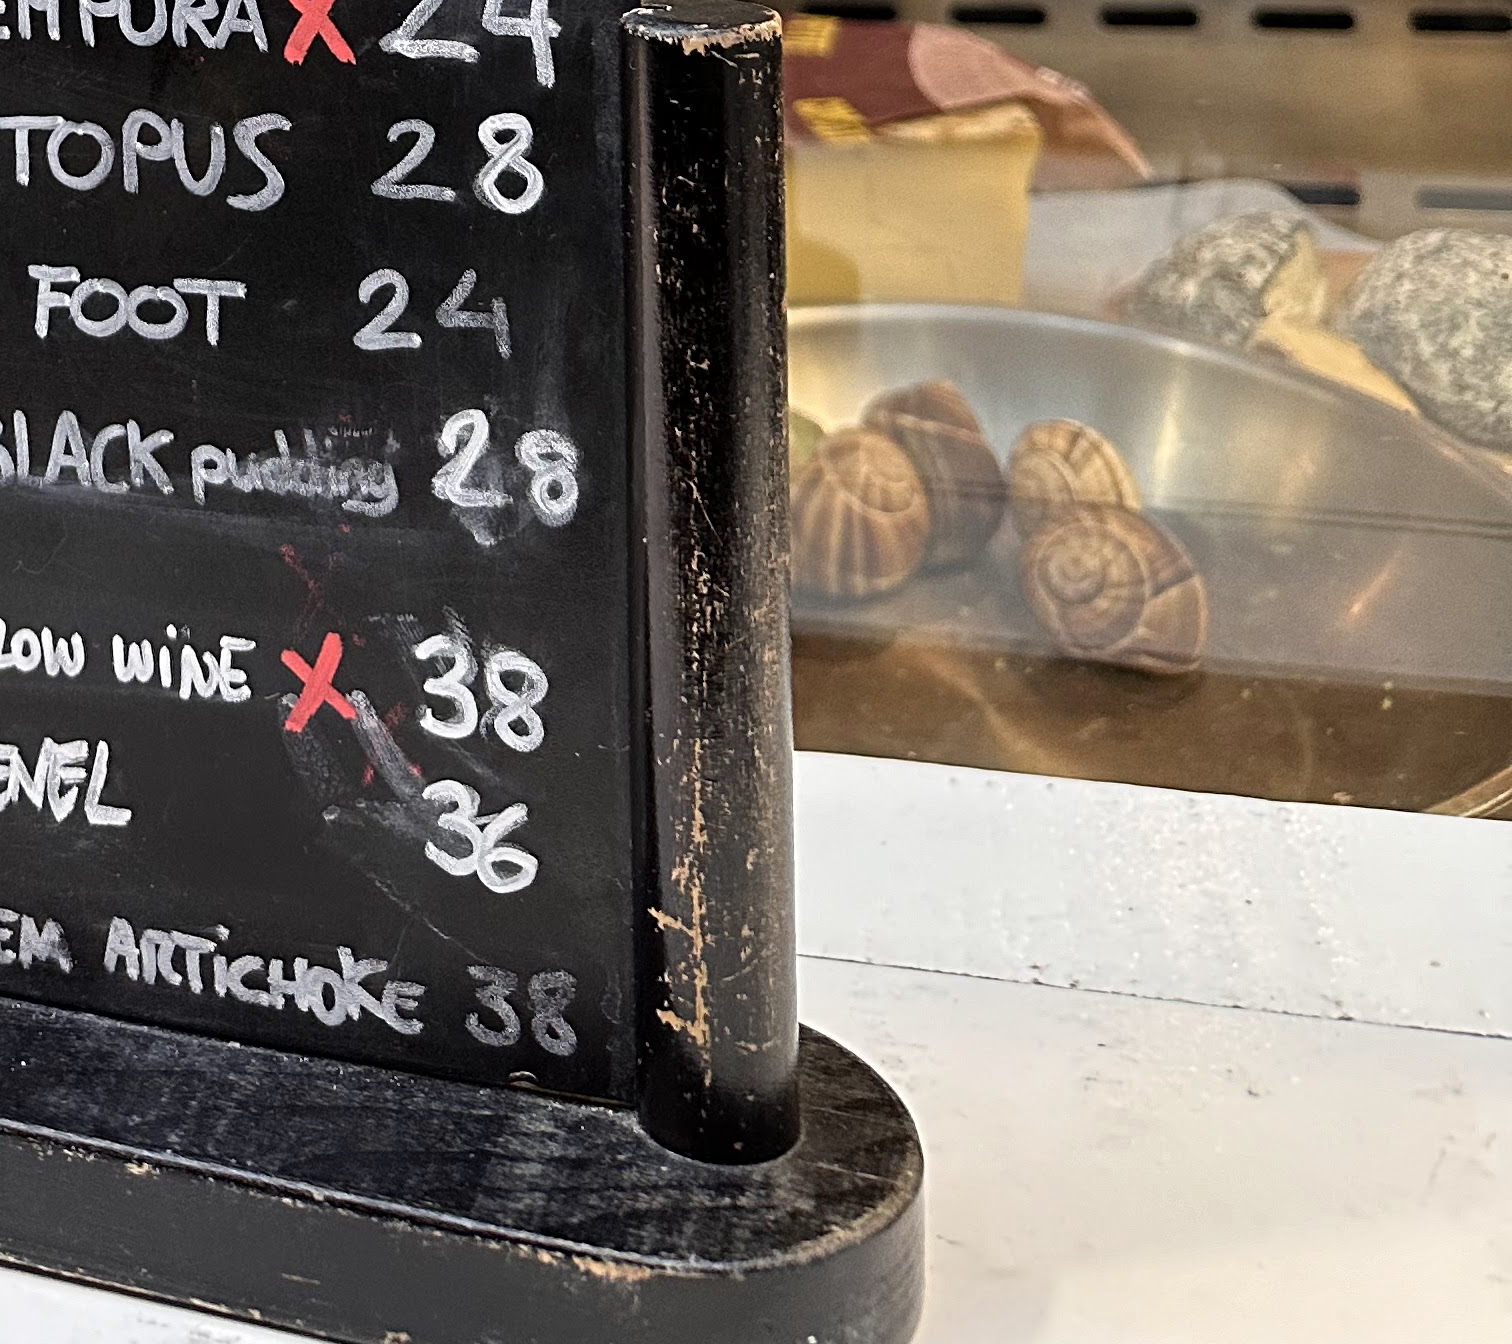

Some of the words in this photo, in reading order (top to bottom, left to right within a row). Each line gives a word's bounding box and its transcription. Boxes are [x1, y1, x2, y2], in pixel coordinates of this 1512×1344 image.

[371, 112, 545, 215] 28
[27, 264, 248, 346] FOOT
[353, 268, 512, 359] 24
[431, 409, 582, 528] 28
[413, 630, 549, 754] 38
[420, 778, 539, 894] 36
[464, 963, 580, 1058] 38
